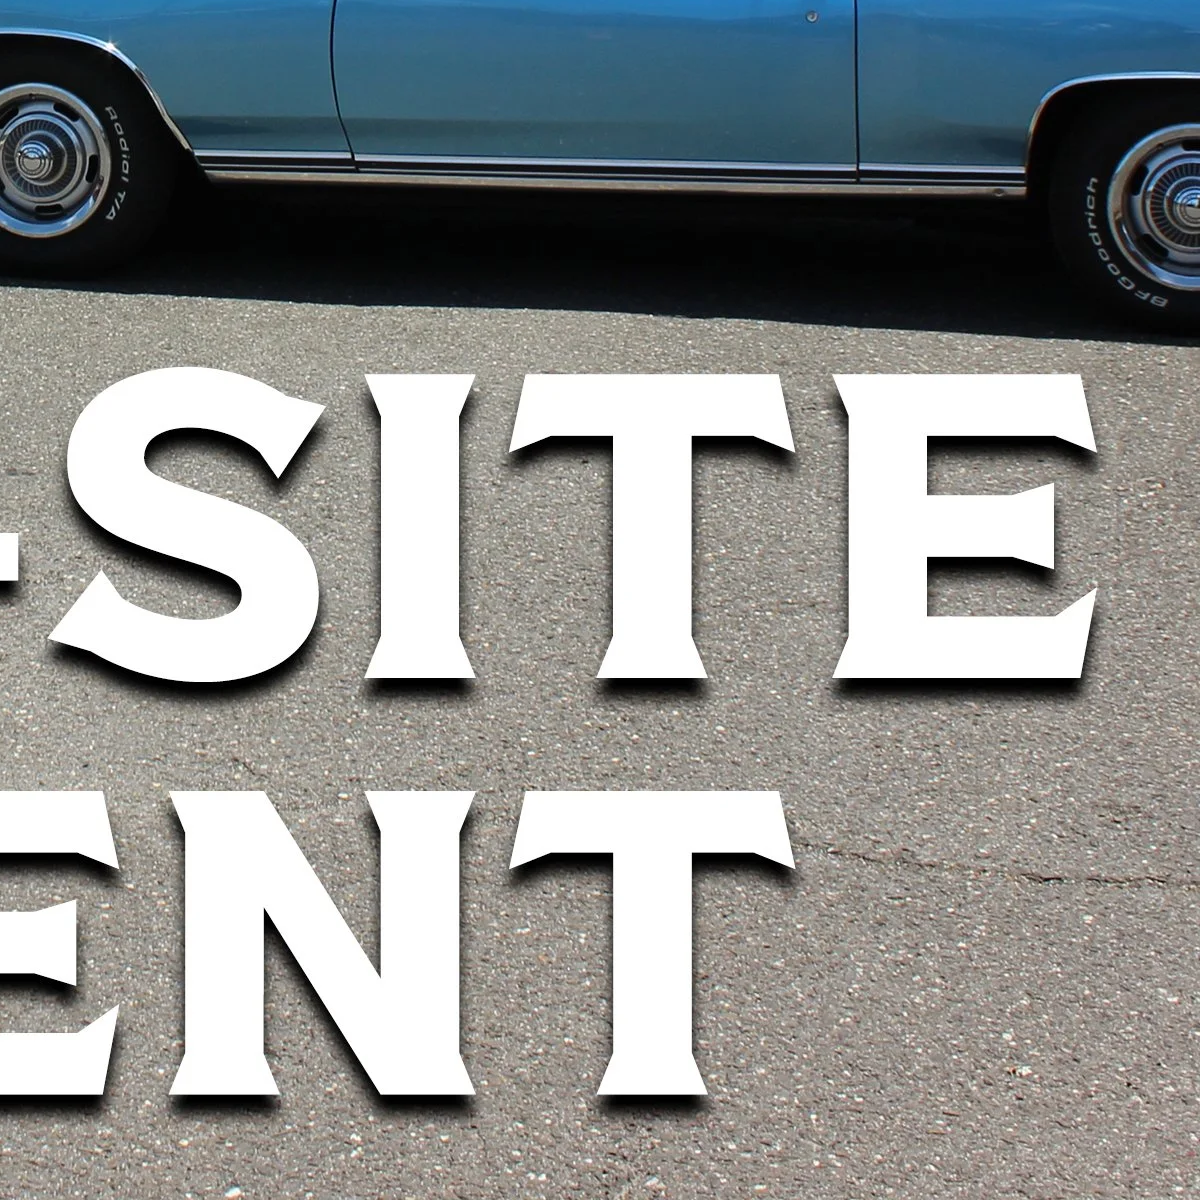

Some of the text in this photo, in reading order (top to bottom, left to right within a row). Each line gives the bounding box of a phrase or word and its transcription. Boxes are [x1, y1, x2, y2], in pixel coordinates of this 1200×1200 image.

[105, 106, 130, 220] Radial T/A
[1084, 177, 1168, 308] BFGoodrich
